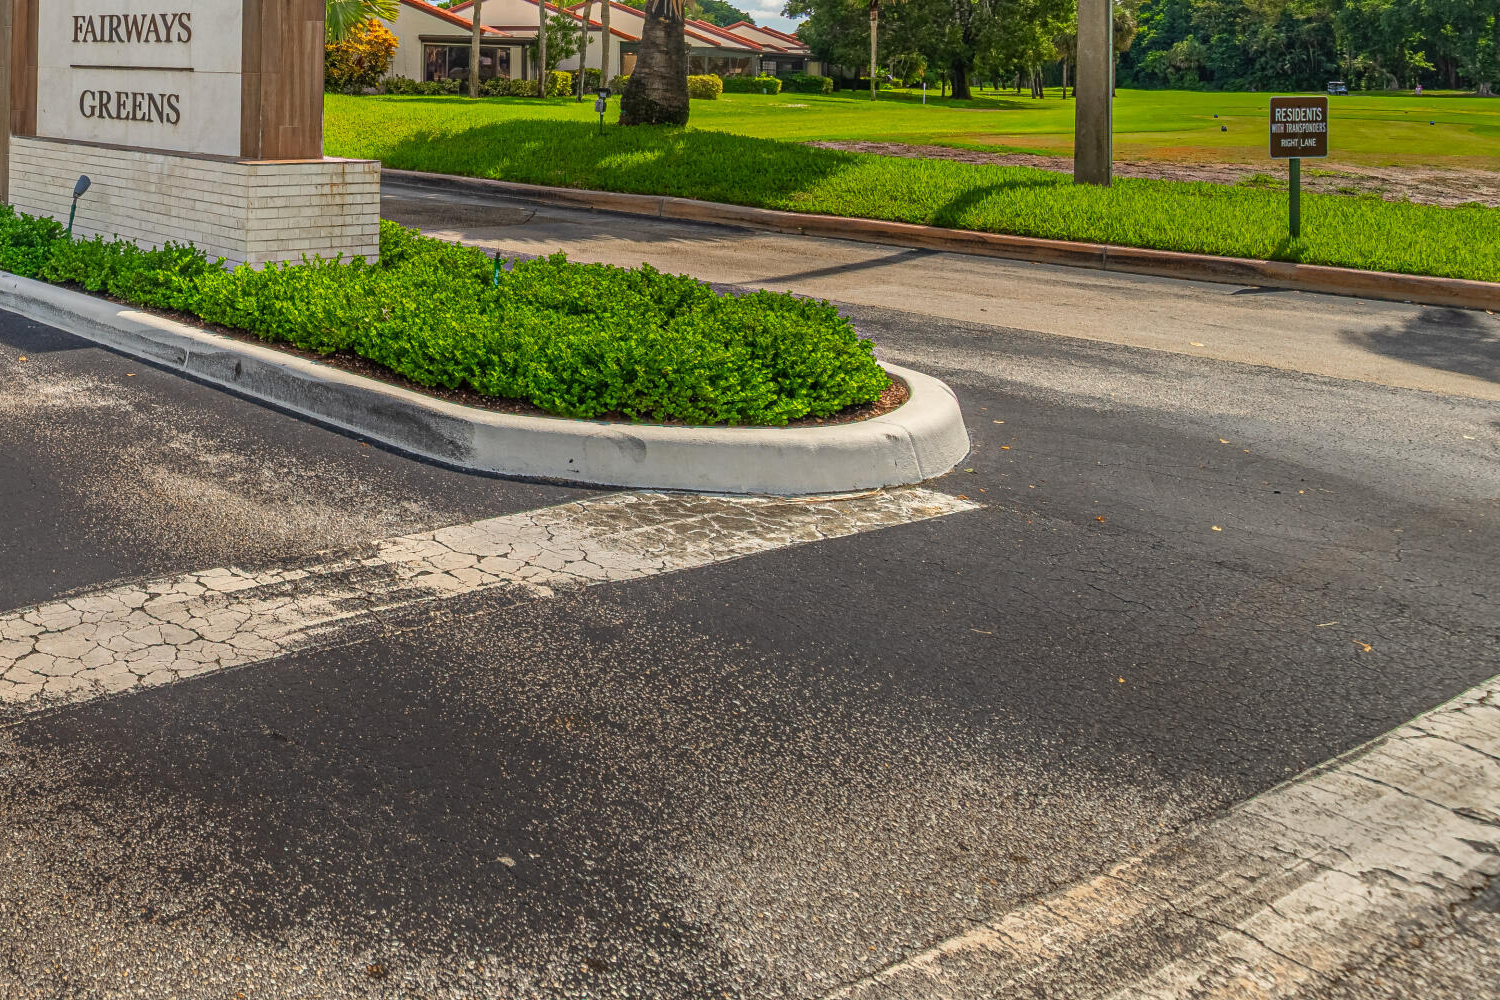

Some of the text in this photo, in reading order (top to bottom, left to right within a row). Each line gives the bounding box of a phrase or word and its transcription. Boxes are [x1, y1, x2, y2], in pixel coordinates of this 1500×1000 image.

[71, 12, 192, 44] FAIRWAYS
[79, 89, 181, 125] GREENS
[1275, 107, 1323, 122] RESIDENTS
[1271, 122, 1326, 133] WITH TRANSPONDERS
[1281, 138, 1317, 147] RIGHT LANE
